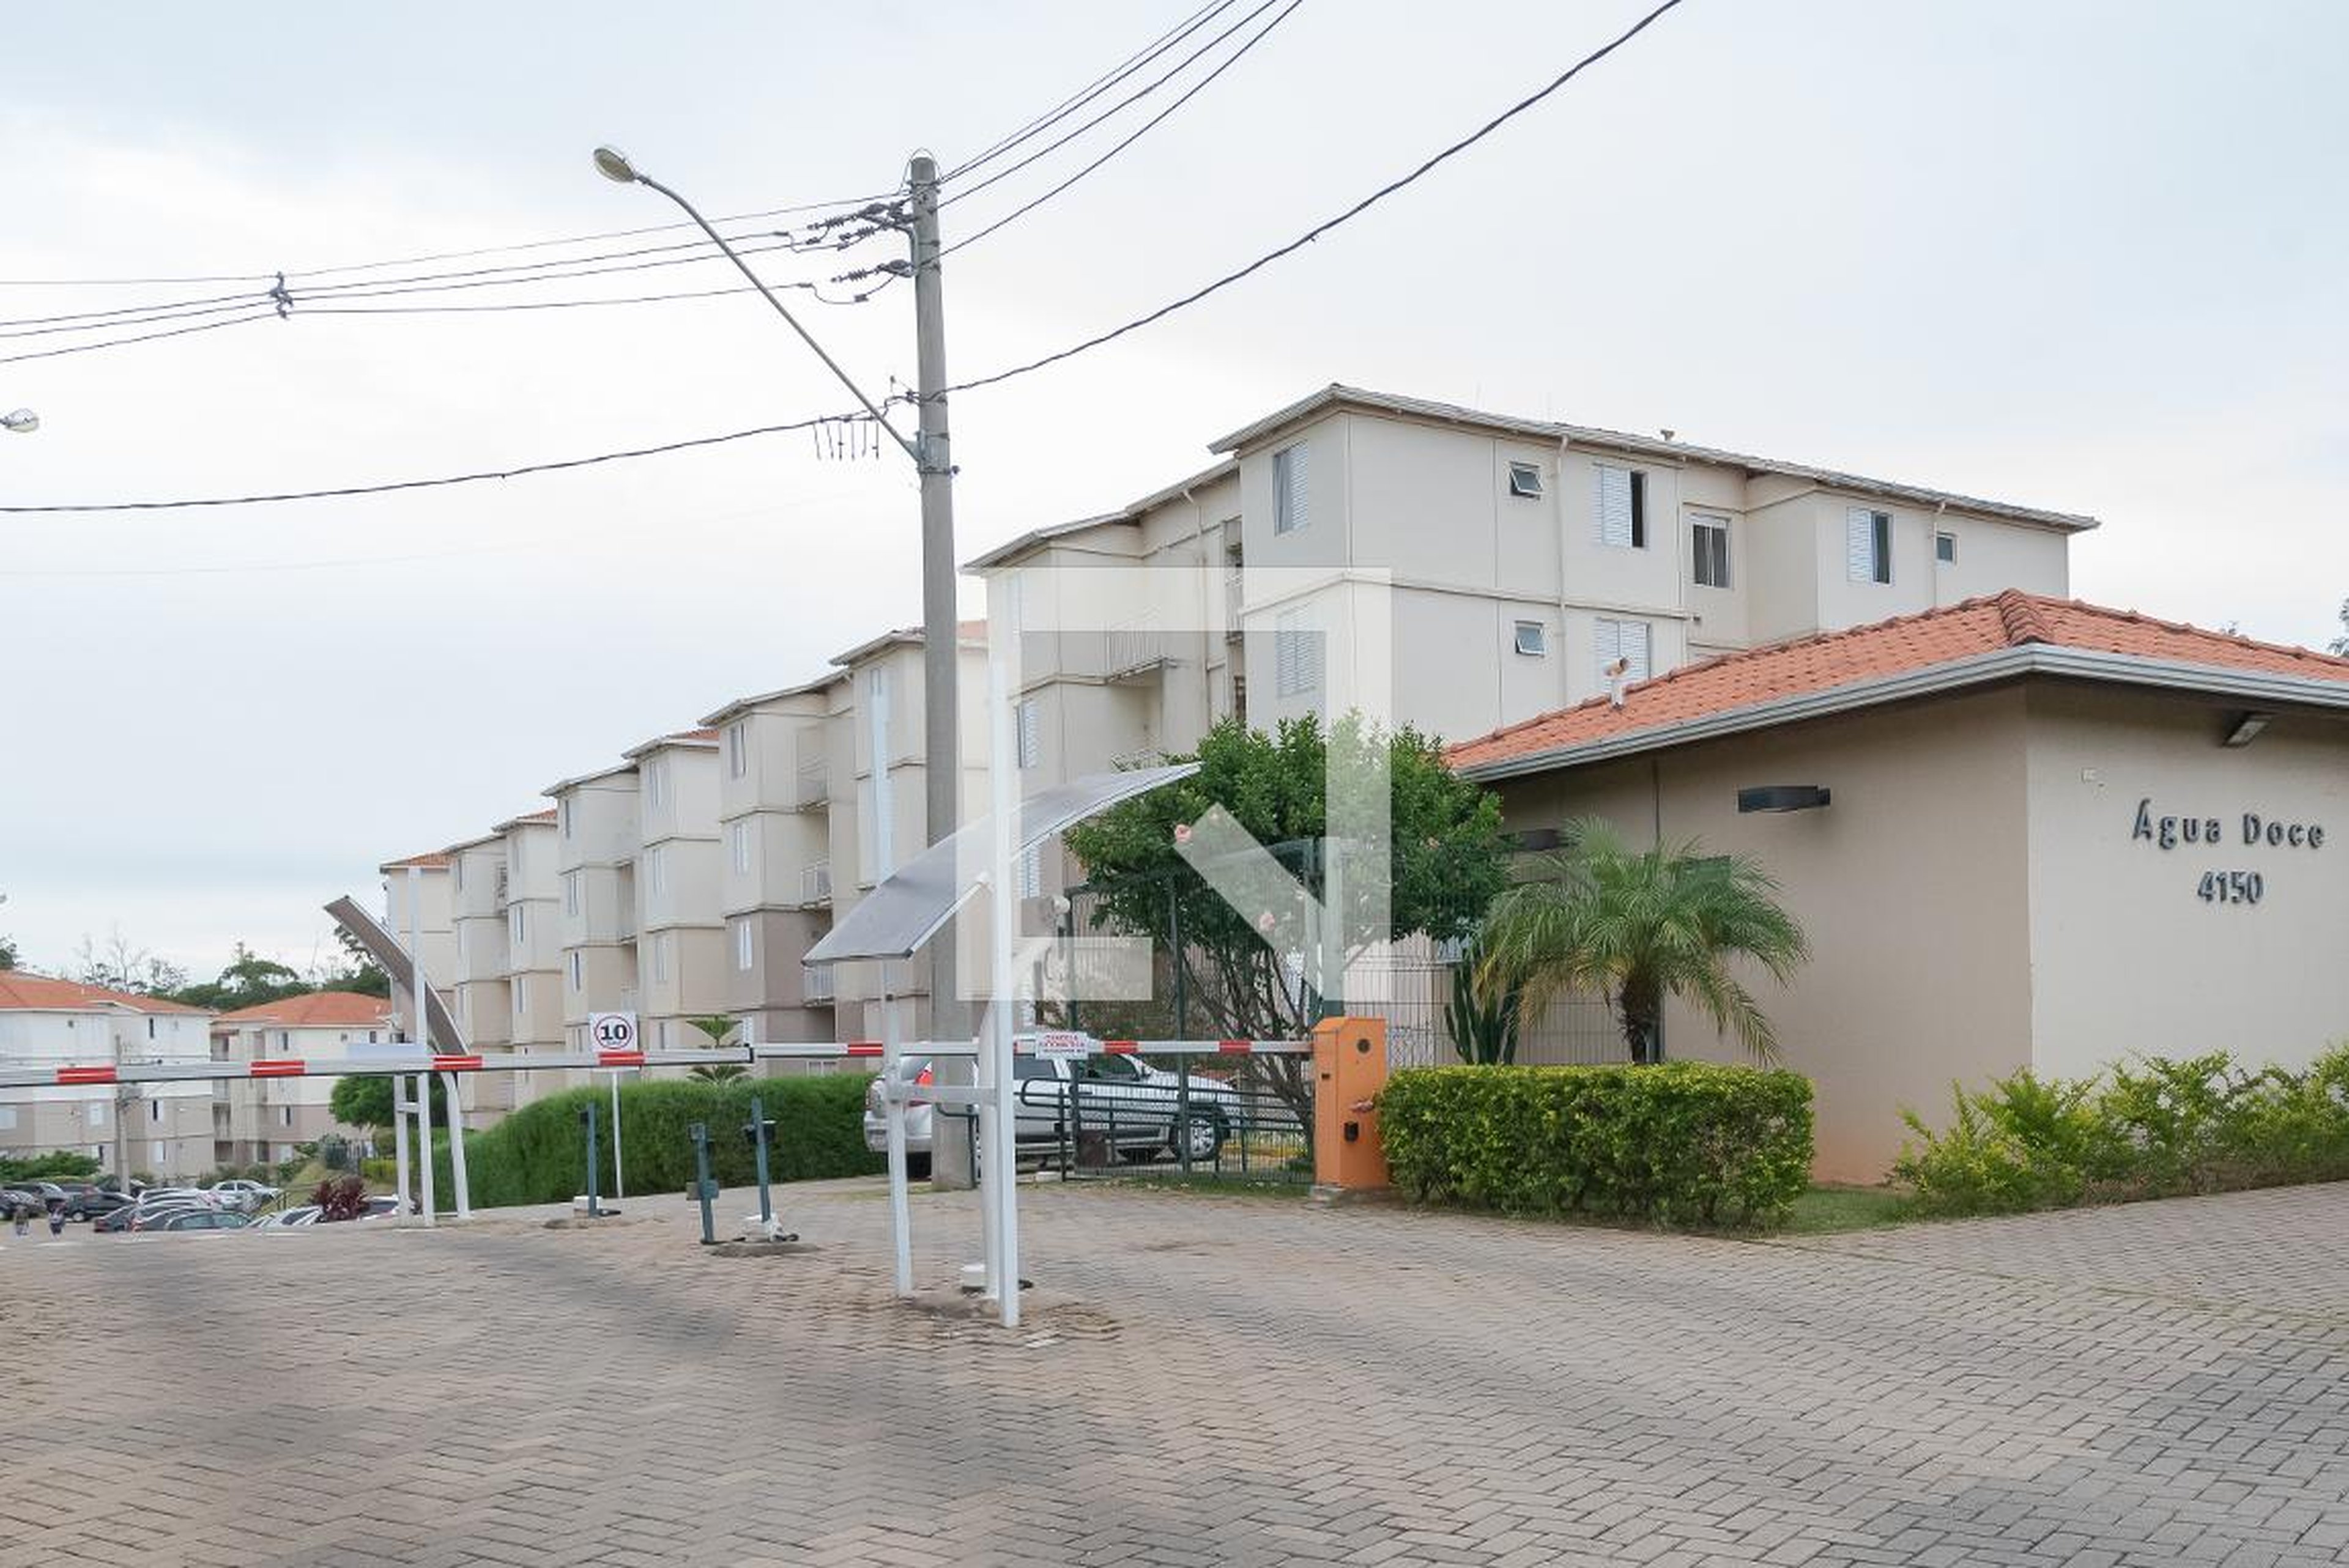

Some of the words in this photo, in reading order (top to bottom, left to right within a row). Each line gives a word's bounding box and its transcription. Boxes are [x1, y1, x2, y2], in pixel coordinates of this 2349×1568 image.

[2132, 798, 2222, 851] Água
[2243, 812, 2325, 849] Doce
[2197, 870, 2264, 904] 4150
[600, 1024, 628, 1040] 10
